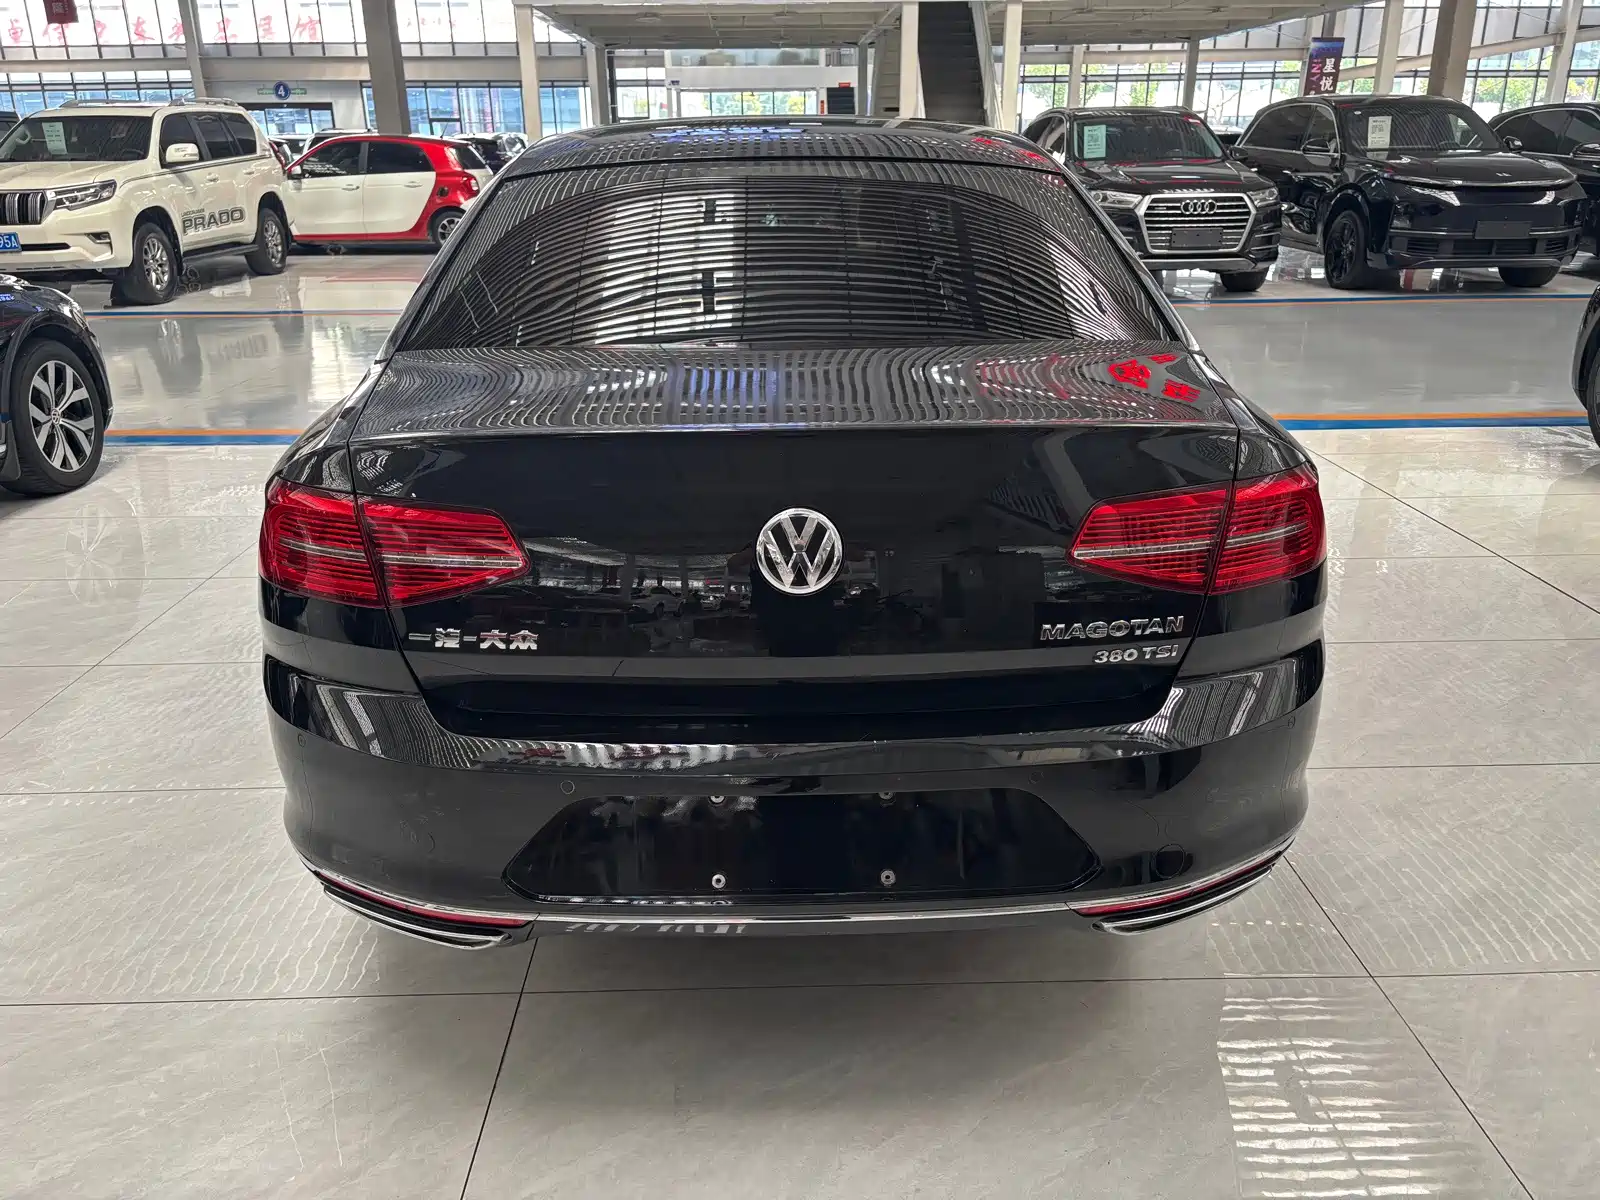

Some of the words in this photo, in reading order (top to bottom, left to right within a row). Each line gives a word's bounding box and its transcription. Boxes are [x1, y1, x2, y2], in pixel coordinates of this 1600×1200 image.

[278, 85, 286, 97] 4
[181, 206, 246, 236] PRADO
[1040, 616, 1184, 640] MAGOTAN
[1094, 649, 1139, 663] 380
[1142, 645, 1179, 659] TSI
